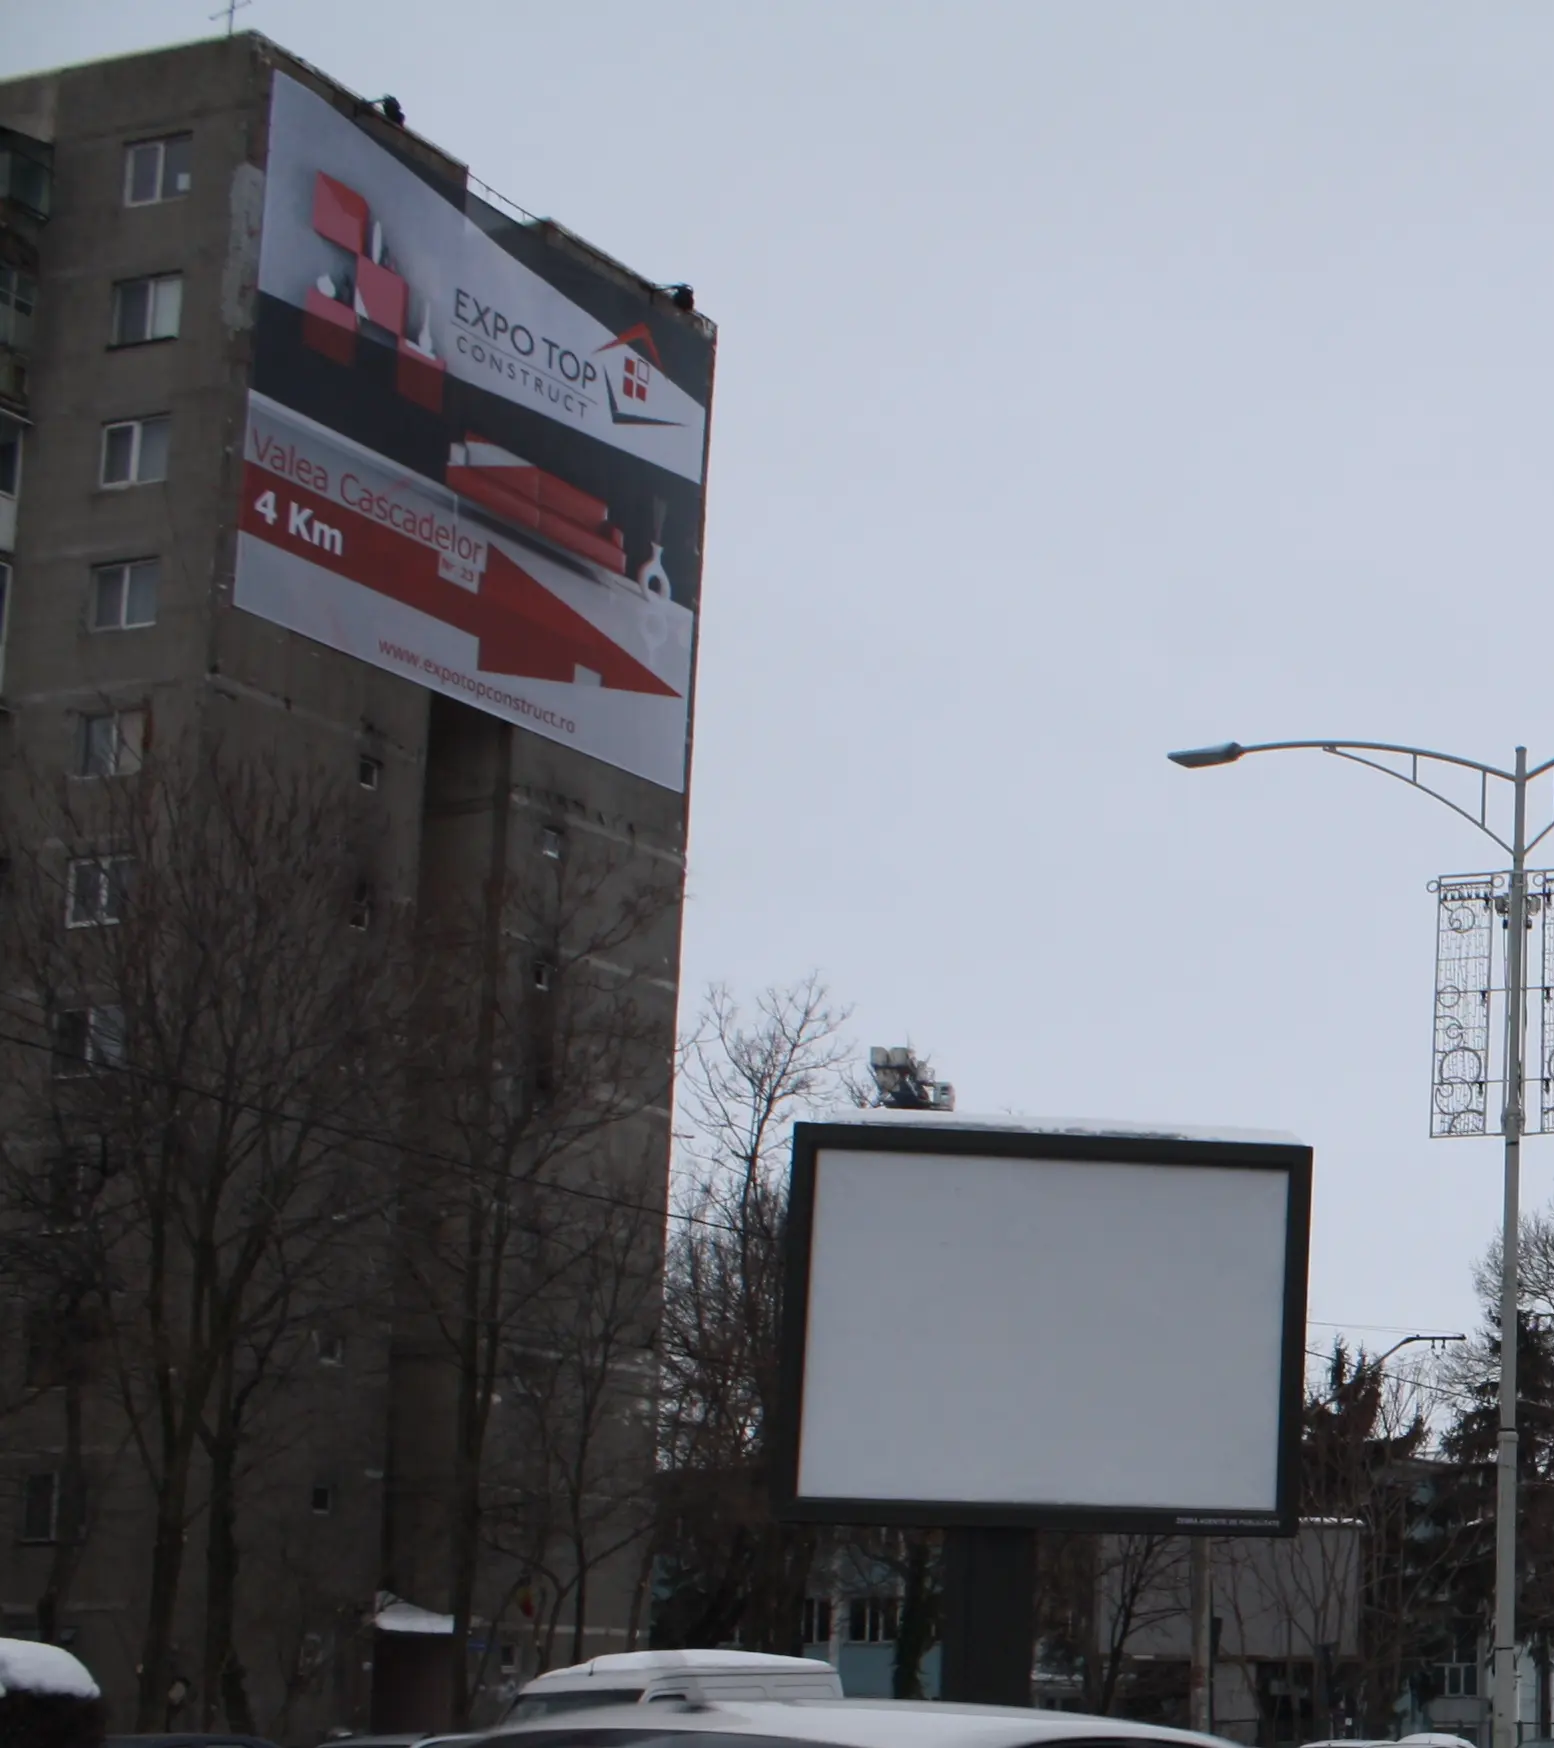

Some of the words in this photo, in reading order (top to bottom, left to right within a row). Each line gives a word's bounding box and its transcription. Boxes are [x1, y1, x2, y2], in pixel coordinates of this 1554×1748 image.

[454, 288, 534, 356] EXPO
[541, 336, 597, 389] TOP
[456, 335, 588, 419] CONSTRUCT
[252, 427, 329, 493] Valea
[340, 473, 483, 564] Cascadelor
[254, 489, 278, 526] 4
[288, 500, 344, 556] Km
[378, 639, 576, 734] www.expotopconstruct.ro
